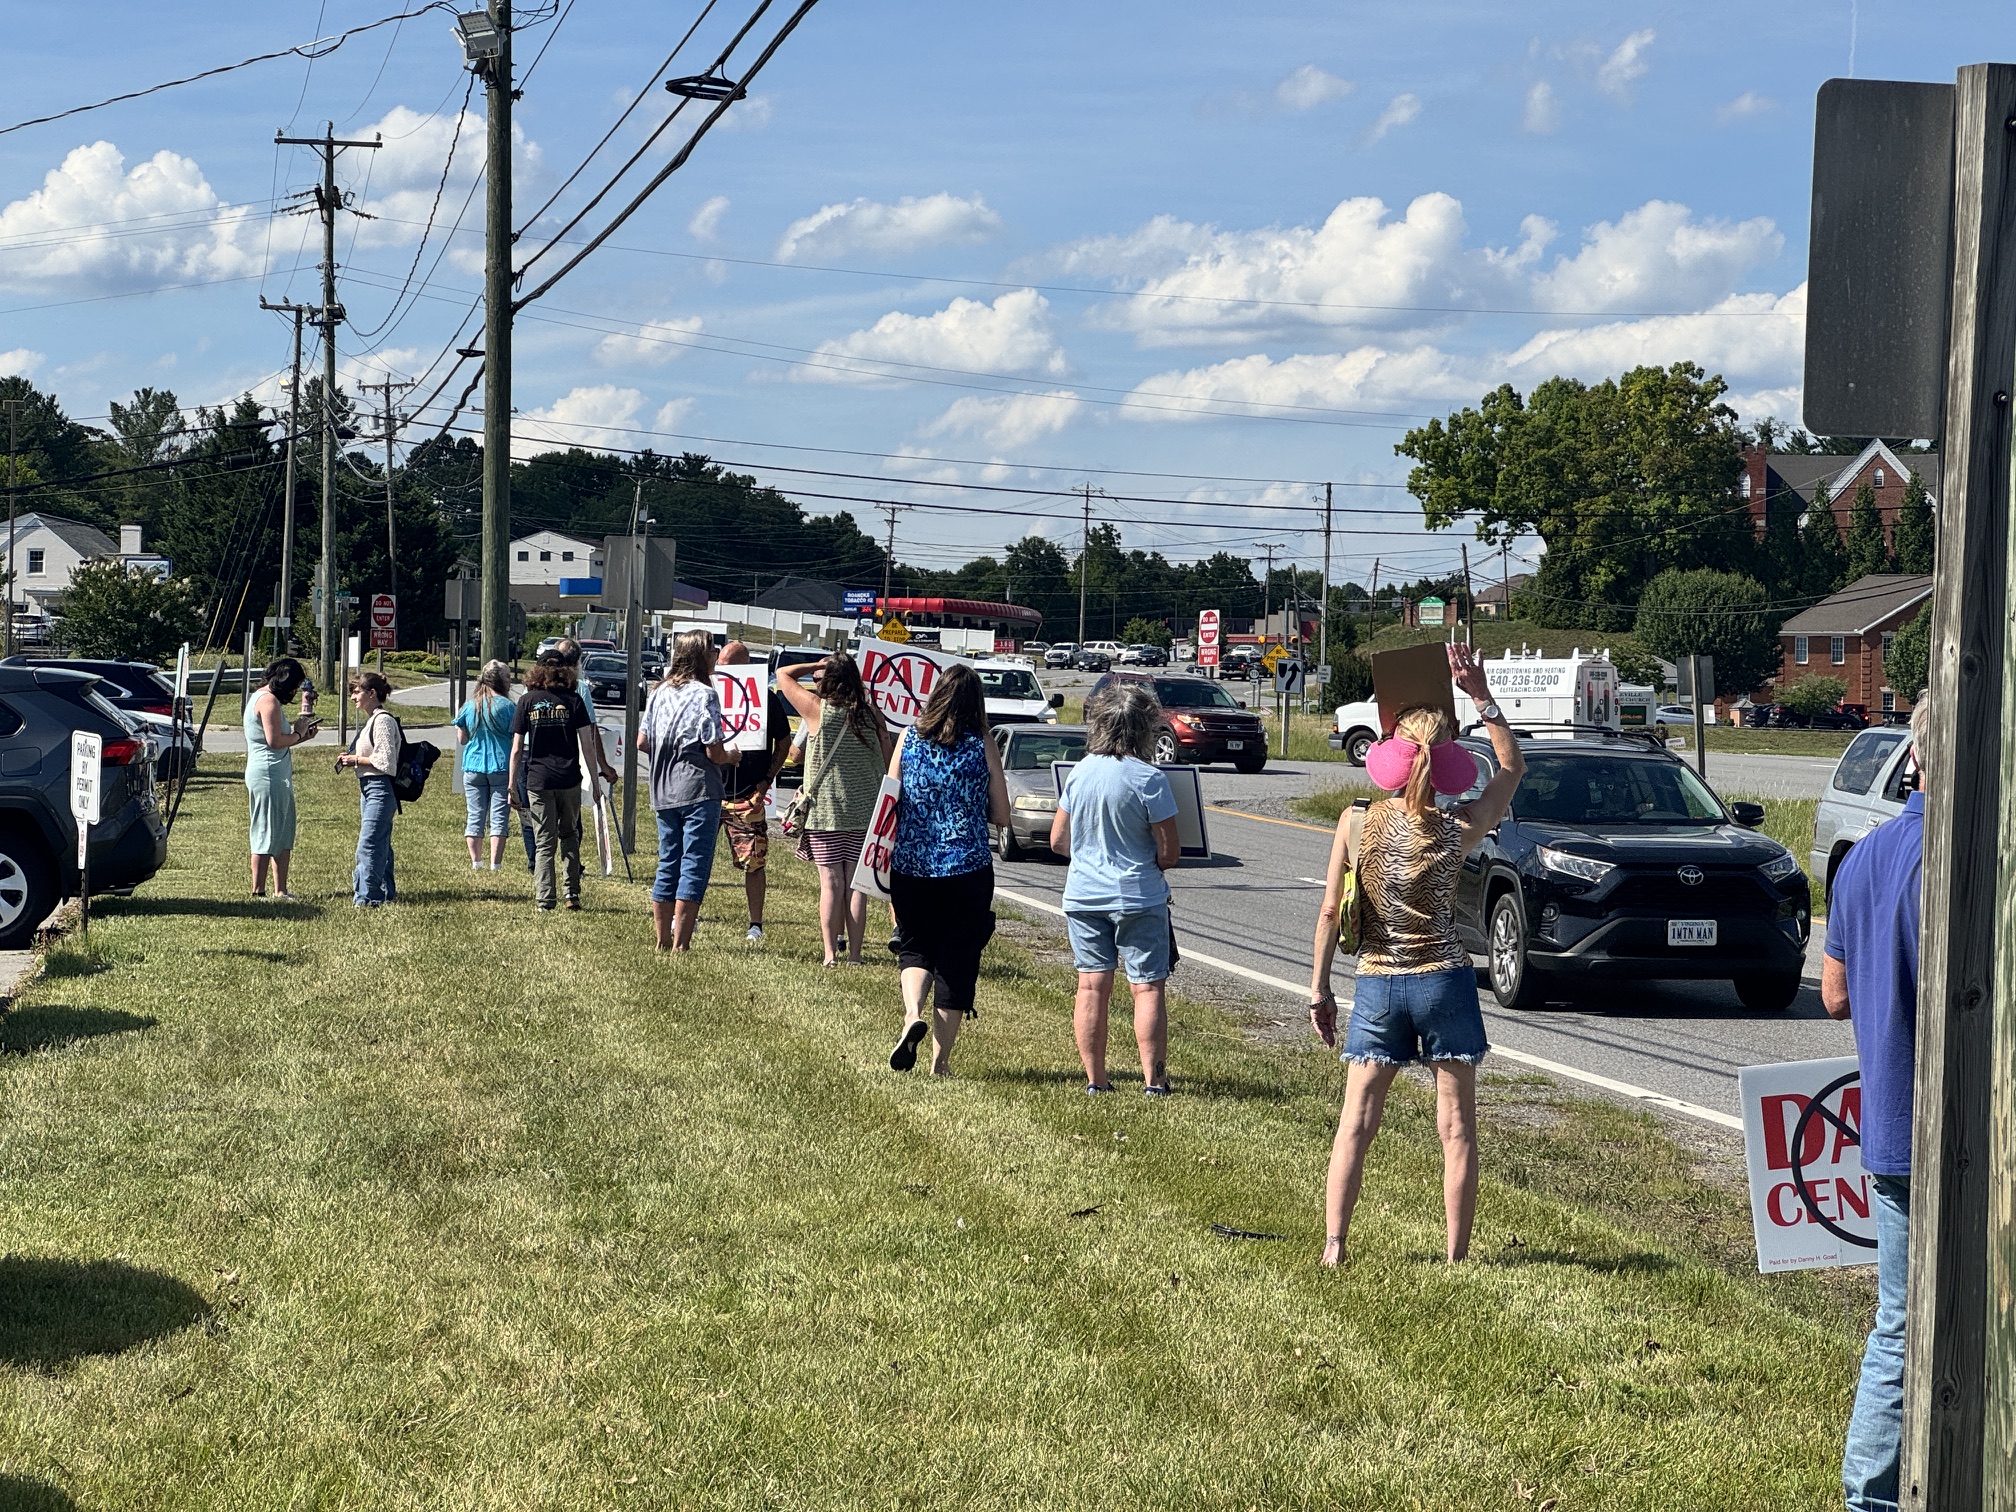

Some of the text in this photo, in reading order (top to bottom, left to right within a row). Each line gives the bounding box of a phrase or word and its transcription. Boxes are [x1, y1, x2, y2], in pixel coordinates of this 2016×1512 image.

[373, 631, 393, 639] WRONG
[376, 639, 388, 647] WAY
[1200, 648, 1217, 656] WRONG
[1490, 675, 1559, 686] 540-236-0200
[76, 742, 96, 759] PARKING
[81, 761, 88, 775] BY
[76, 777, 93, 793] PERMIT
[78, 795, 90, 810] ONLY
[1696, 927, 1714, 940] MAN
